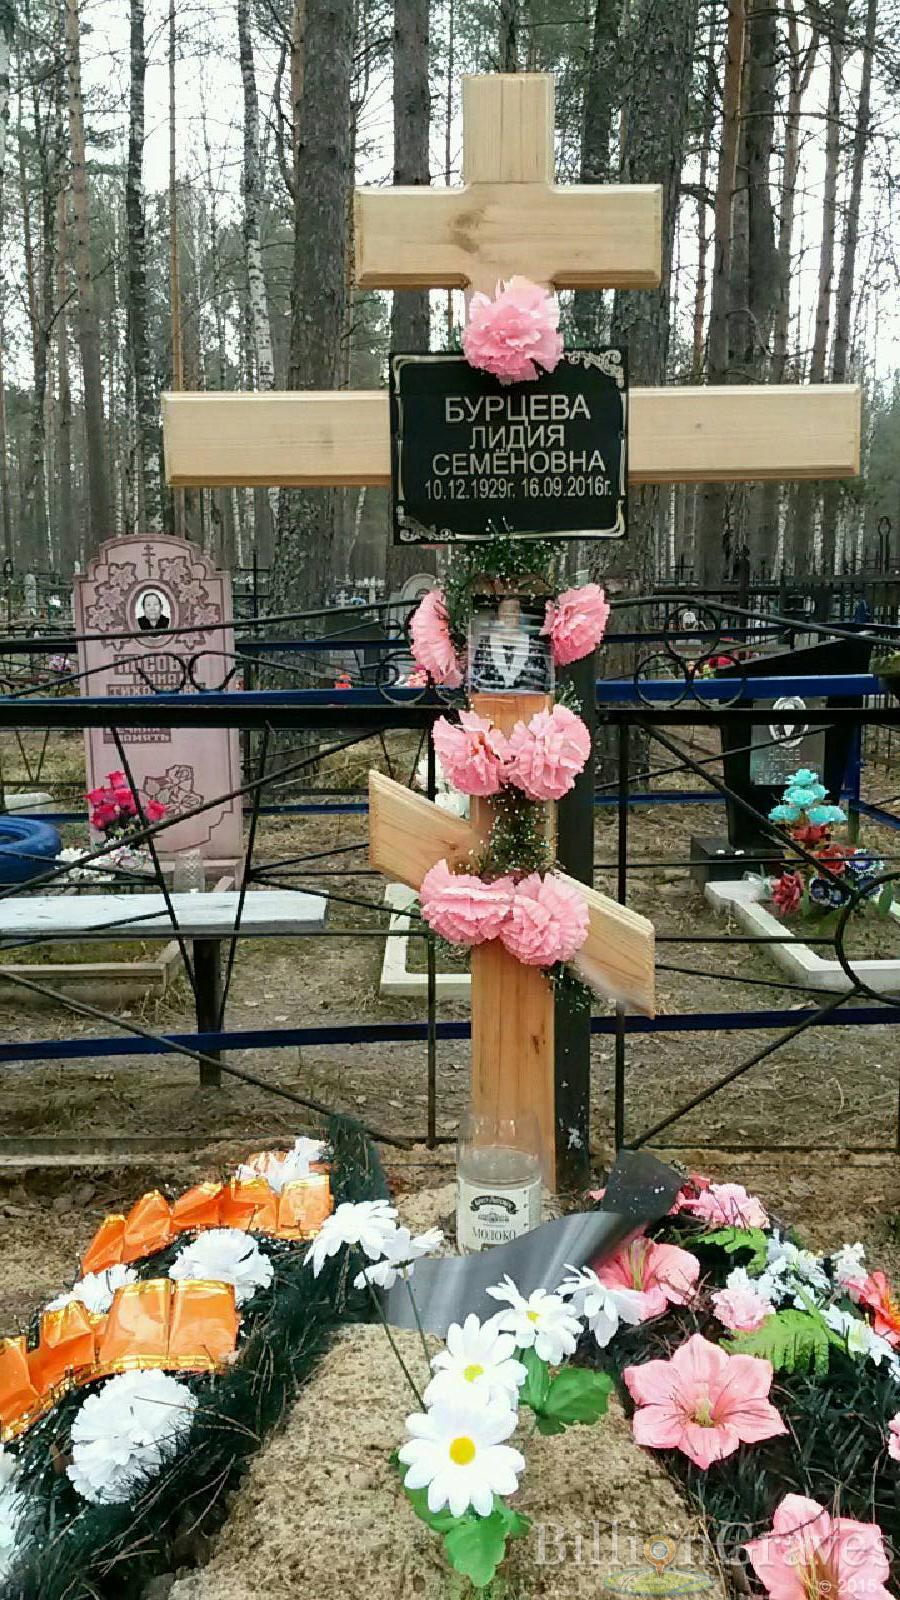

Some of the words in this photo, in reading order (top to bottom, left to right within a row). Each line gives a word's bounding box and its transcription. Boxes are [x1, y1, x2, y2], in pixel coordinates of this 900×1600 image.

[445, 394, 591, 426] БУРЦЕВА
[469, 425, 565, 453] ЛИДИЯ
[432, 447, 606, 476] СЕМЁНОВНА
[424, 479, 516, 500] 10.12.1929г.
[521, 476, 612, 498] 16.09.2016г.
